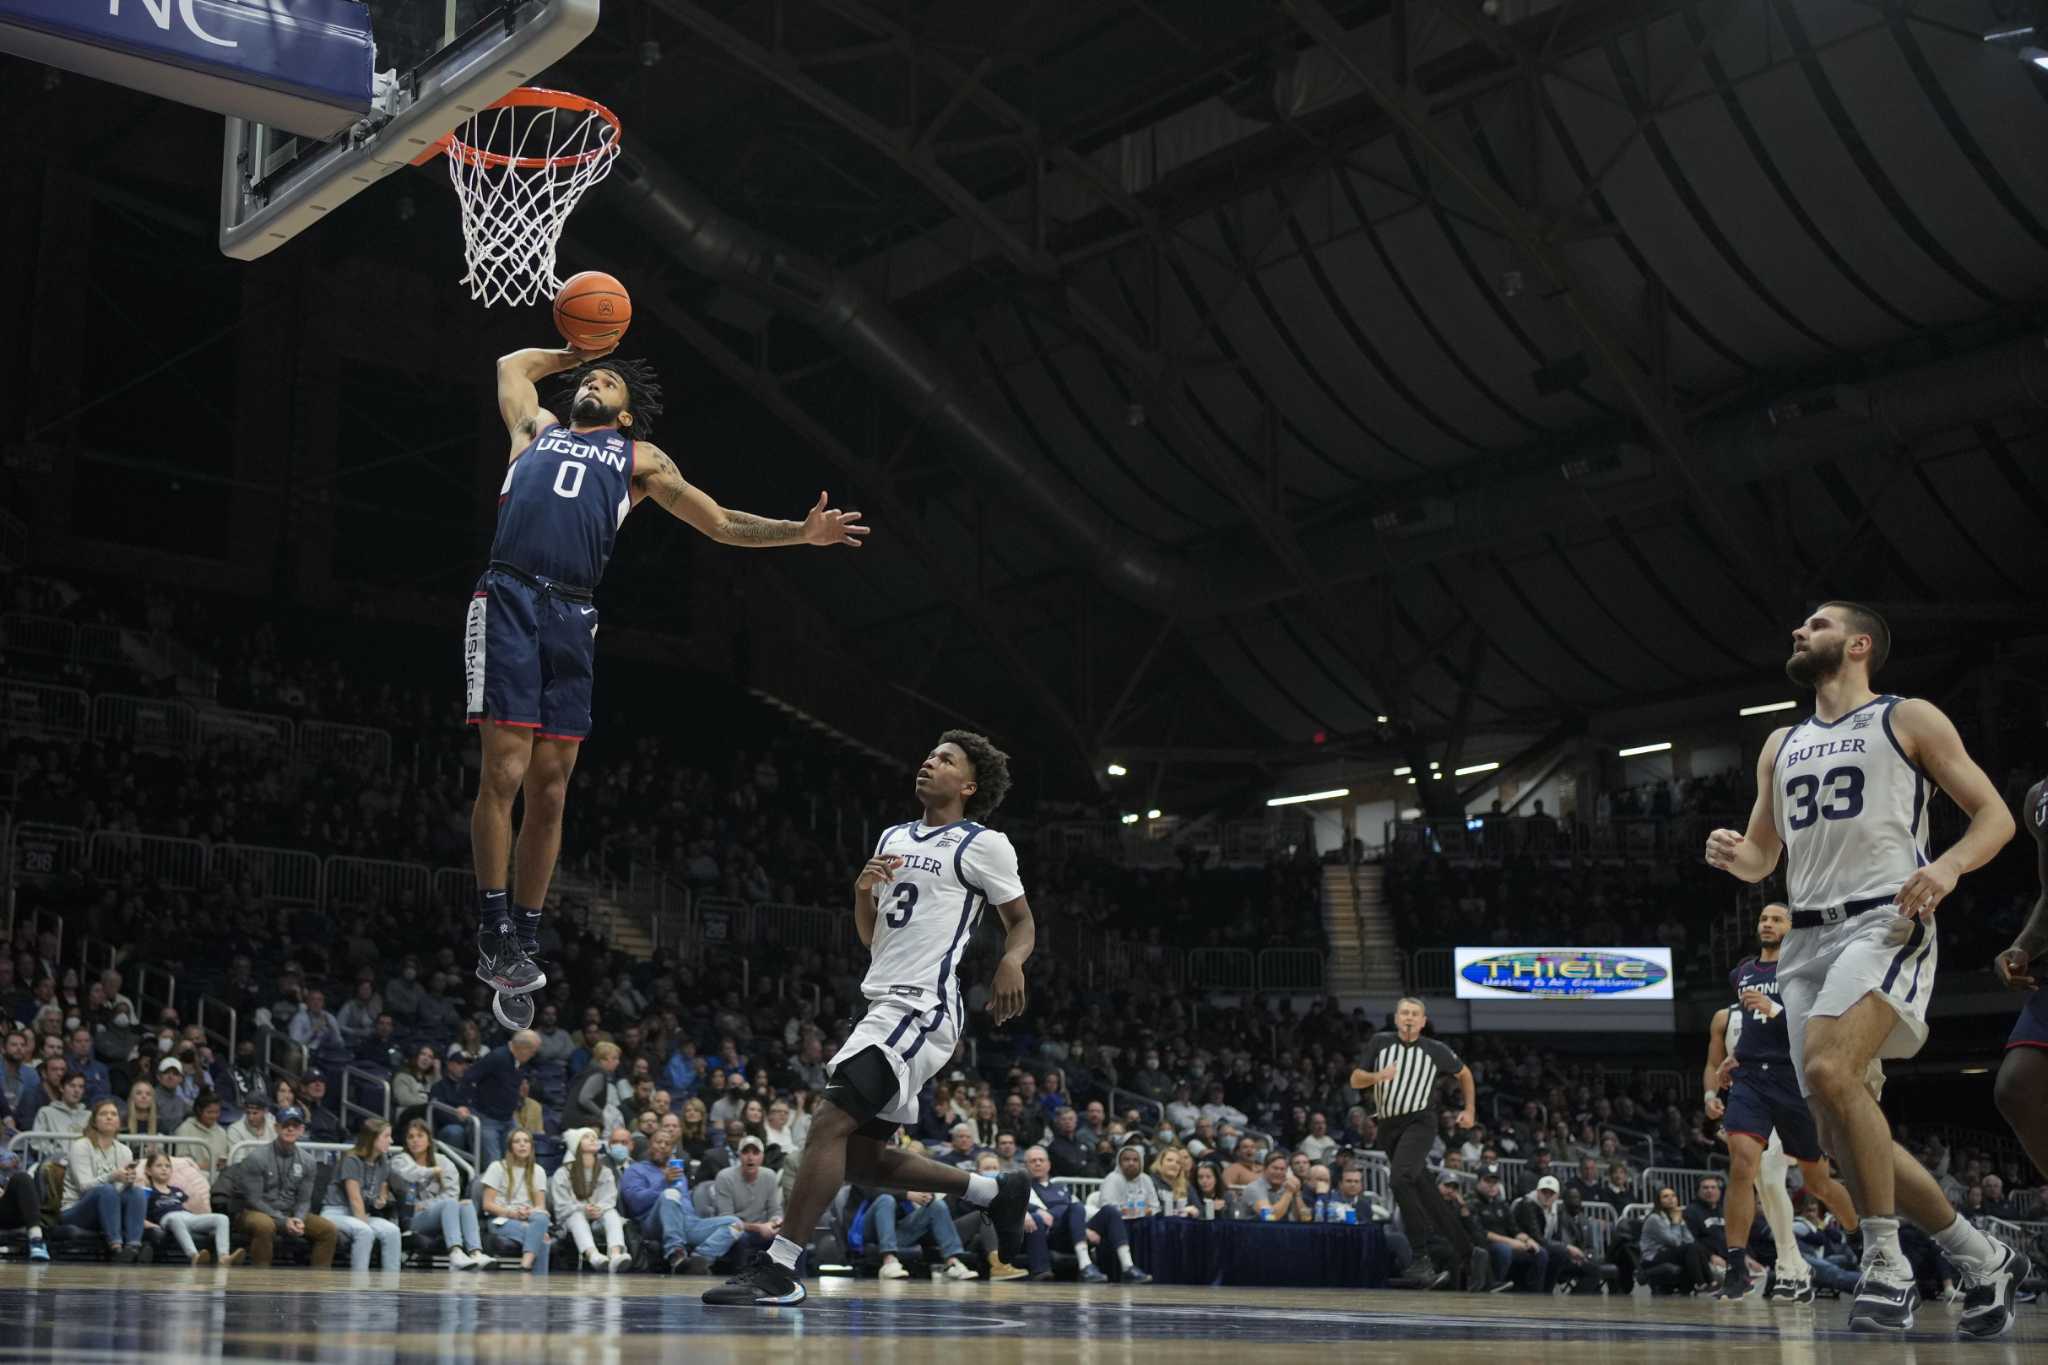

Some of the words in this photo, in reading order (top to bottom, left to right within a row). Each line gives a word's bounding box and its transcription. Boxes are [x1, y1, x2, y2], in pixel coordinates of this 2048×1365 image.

[535, 437, 626, 473] UCONN
[552, 459, 587, 498] 0
[1786, 737, 1867, 769] BUTLER
[1785, 765, 1866, 831] 33
[887, 853, 943, 877] TLER
[885, 881, 920, 929] 3
[1826, 906, 1838, 921] B
[1476, 959, 1649, 979] THIELE
